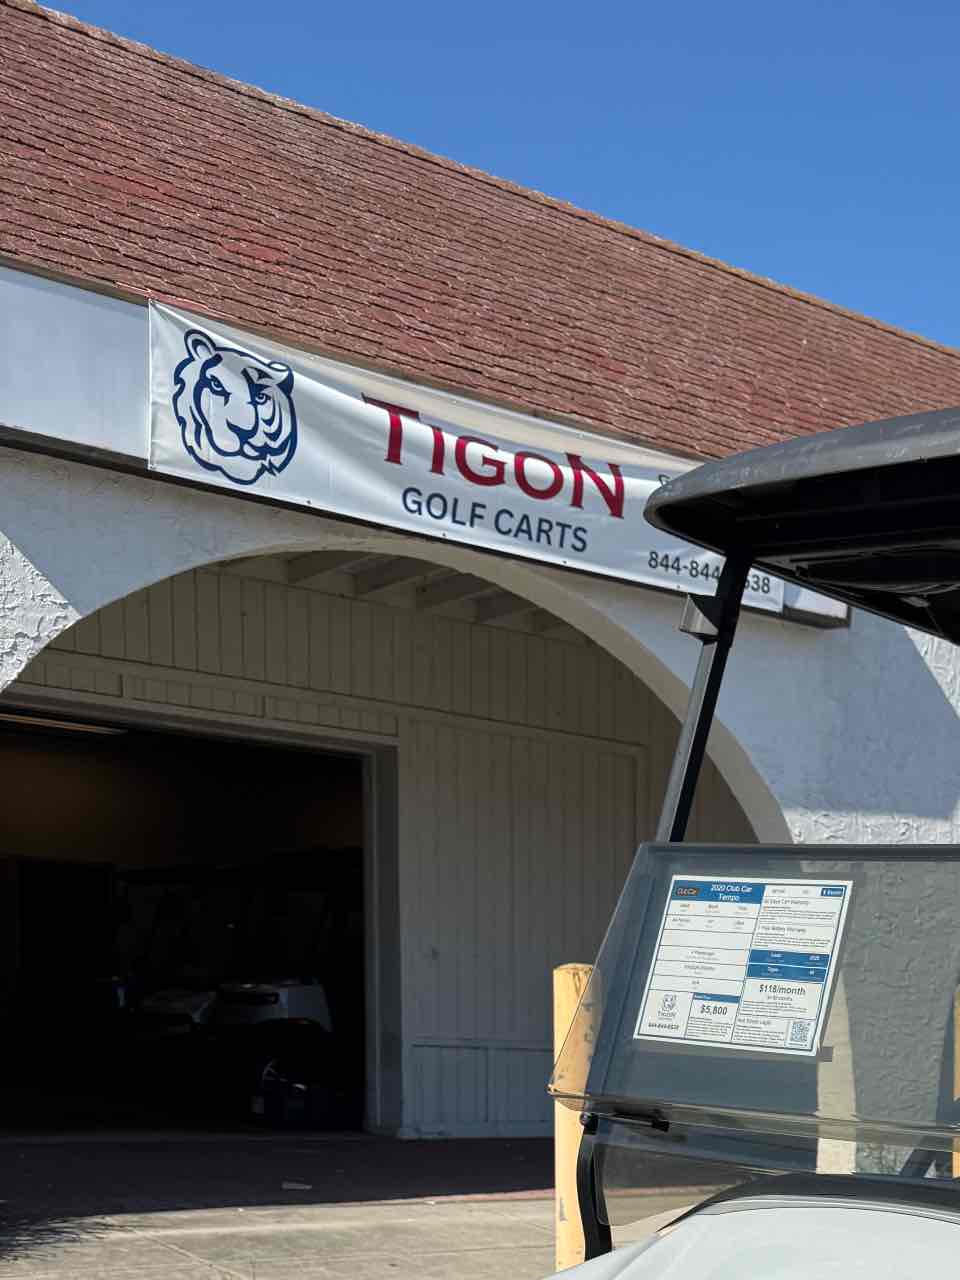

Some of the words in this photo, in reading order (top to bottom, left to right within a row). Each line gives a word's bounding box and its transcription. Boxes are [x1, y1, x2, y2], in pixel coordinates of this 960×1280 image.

[362, 392, 625, 519] TIGON
[402, 486, 486, 528] GOLF
[494, 508, 588, 553] CARTS
[719, 893, 740, 903] Tempo
[701, 1004, 728, 1016] $5,800
